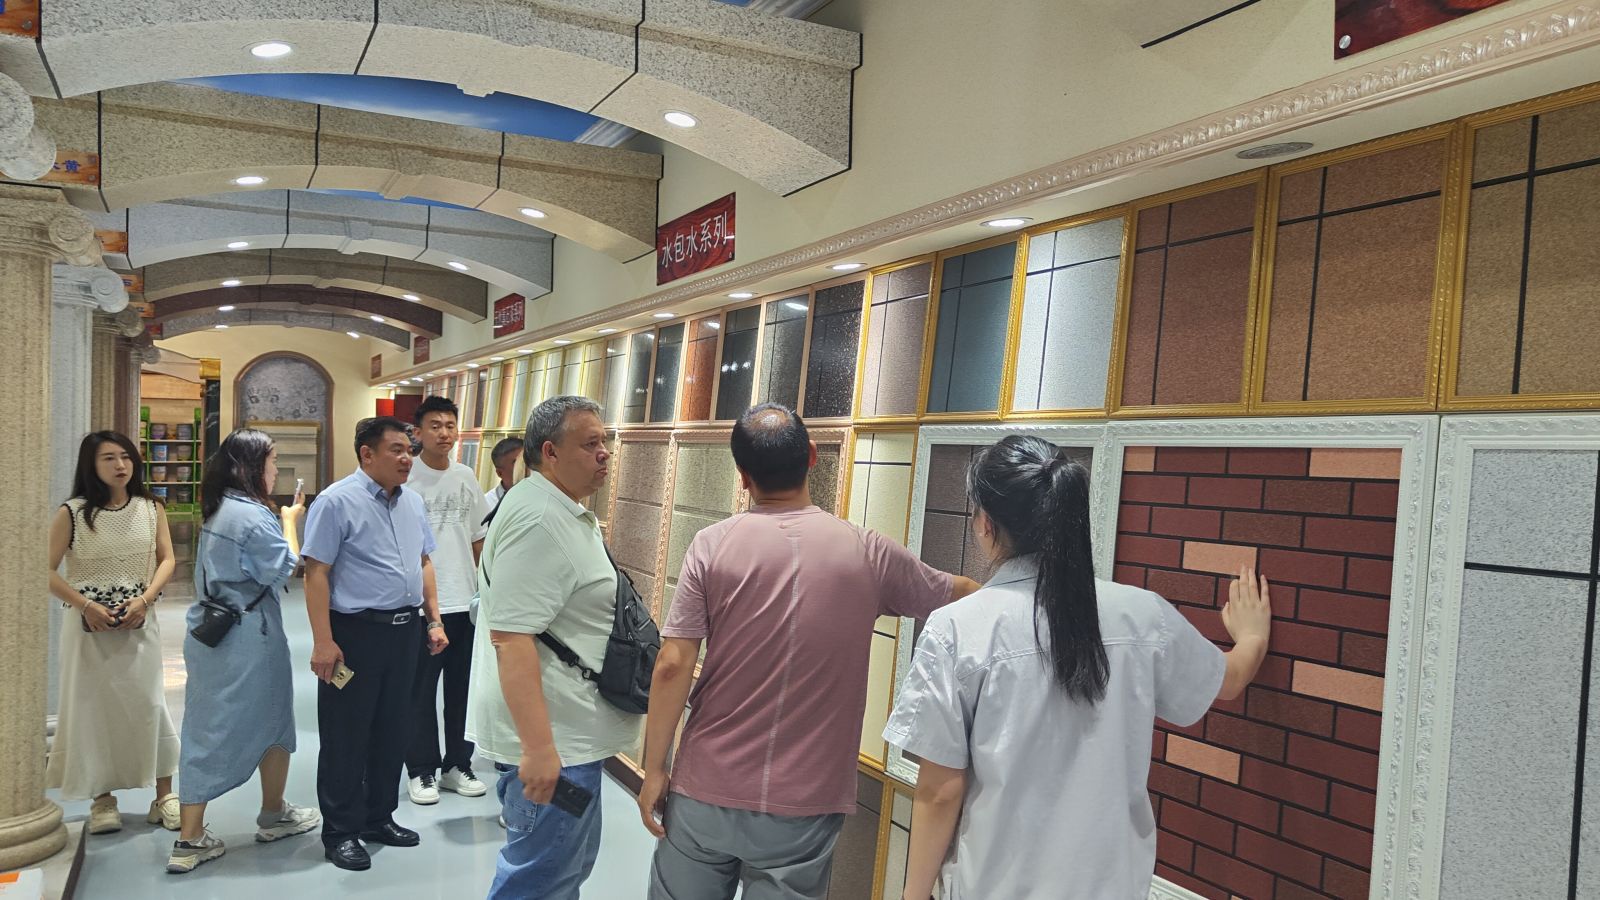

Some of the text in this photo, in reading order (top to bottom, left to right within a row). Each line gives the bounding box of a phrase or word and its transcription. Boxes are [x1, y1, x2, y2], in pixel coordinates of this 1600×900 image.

[661, 210, 728, 269] 水包水系列
